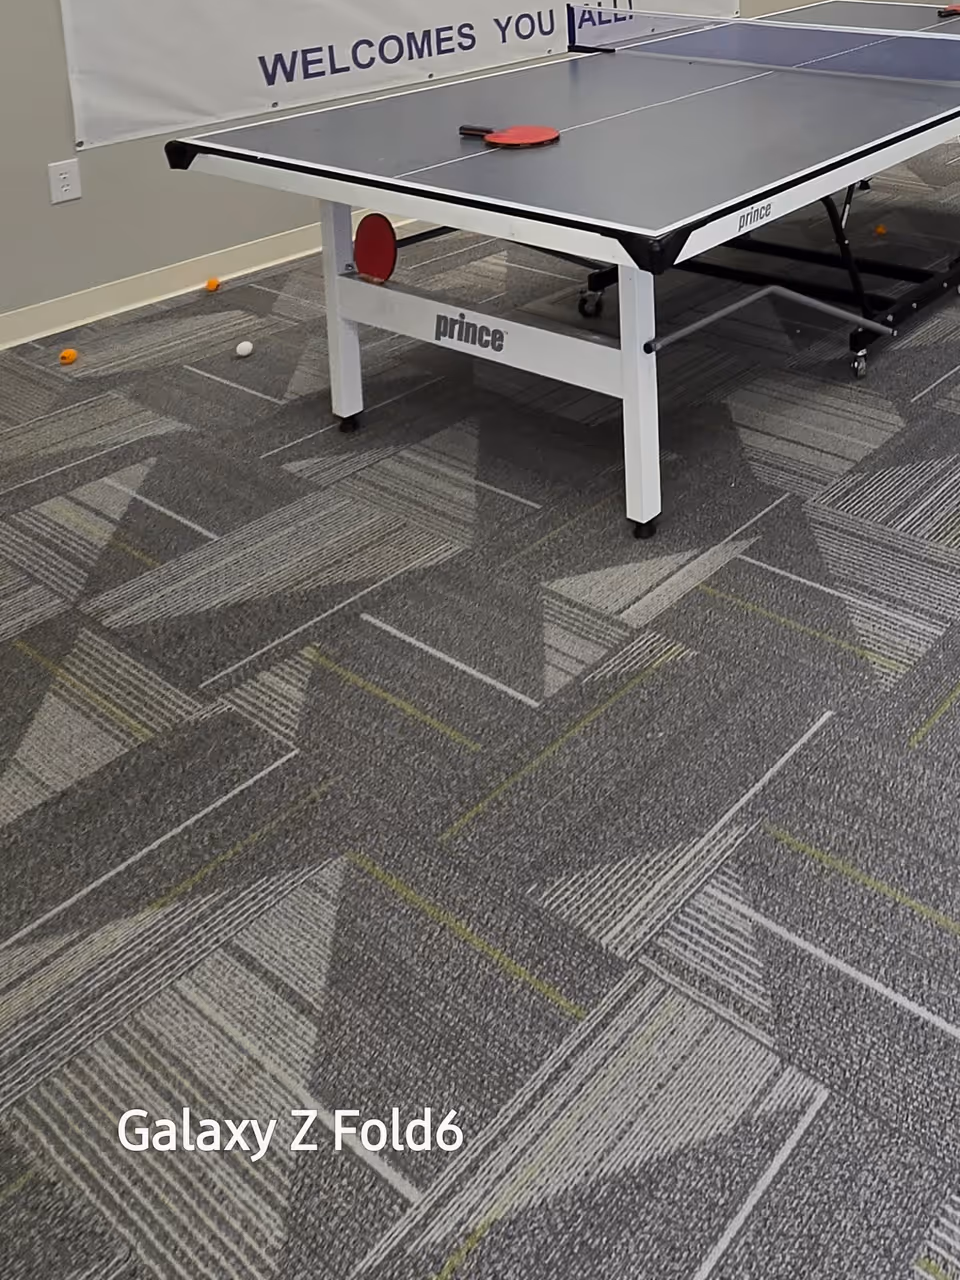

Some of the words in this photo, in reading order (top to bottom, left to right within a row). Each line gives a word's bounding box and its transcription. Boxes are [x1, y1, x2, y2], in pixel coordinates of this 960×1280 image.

[257, 22, 477, 86] WELCOMES
[493, 8, 556, 43] YOU
[737, 203, 772, 232] prince
[434, 312, 505, 352] prince
